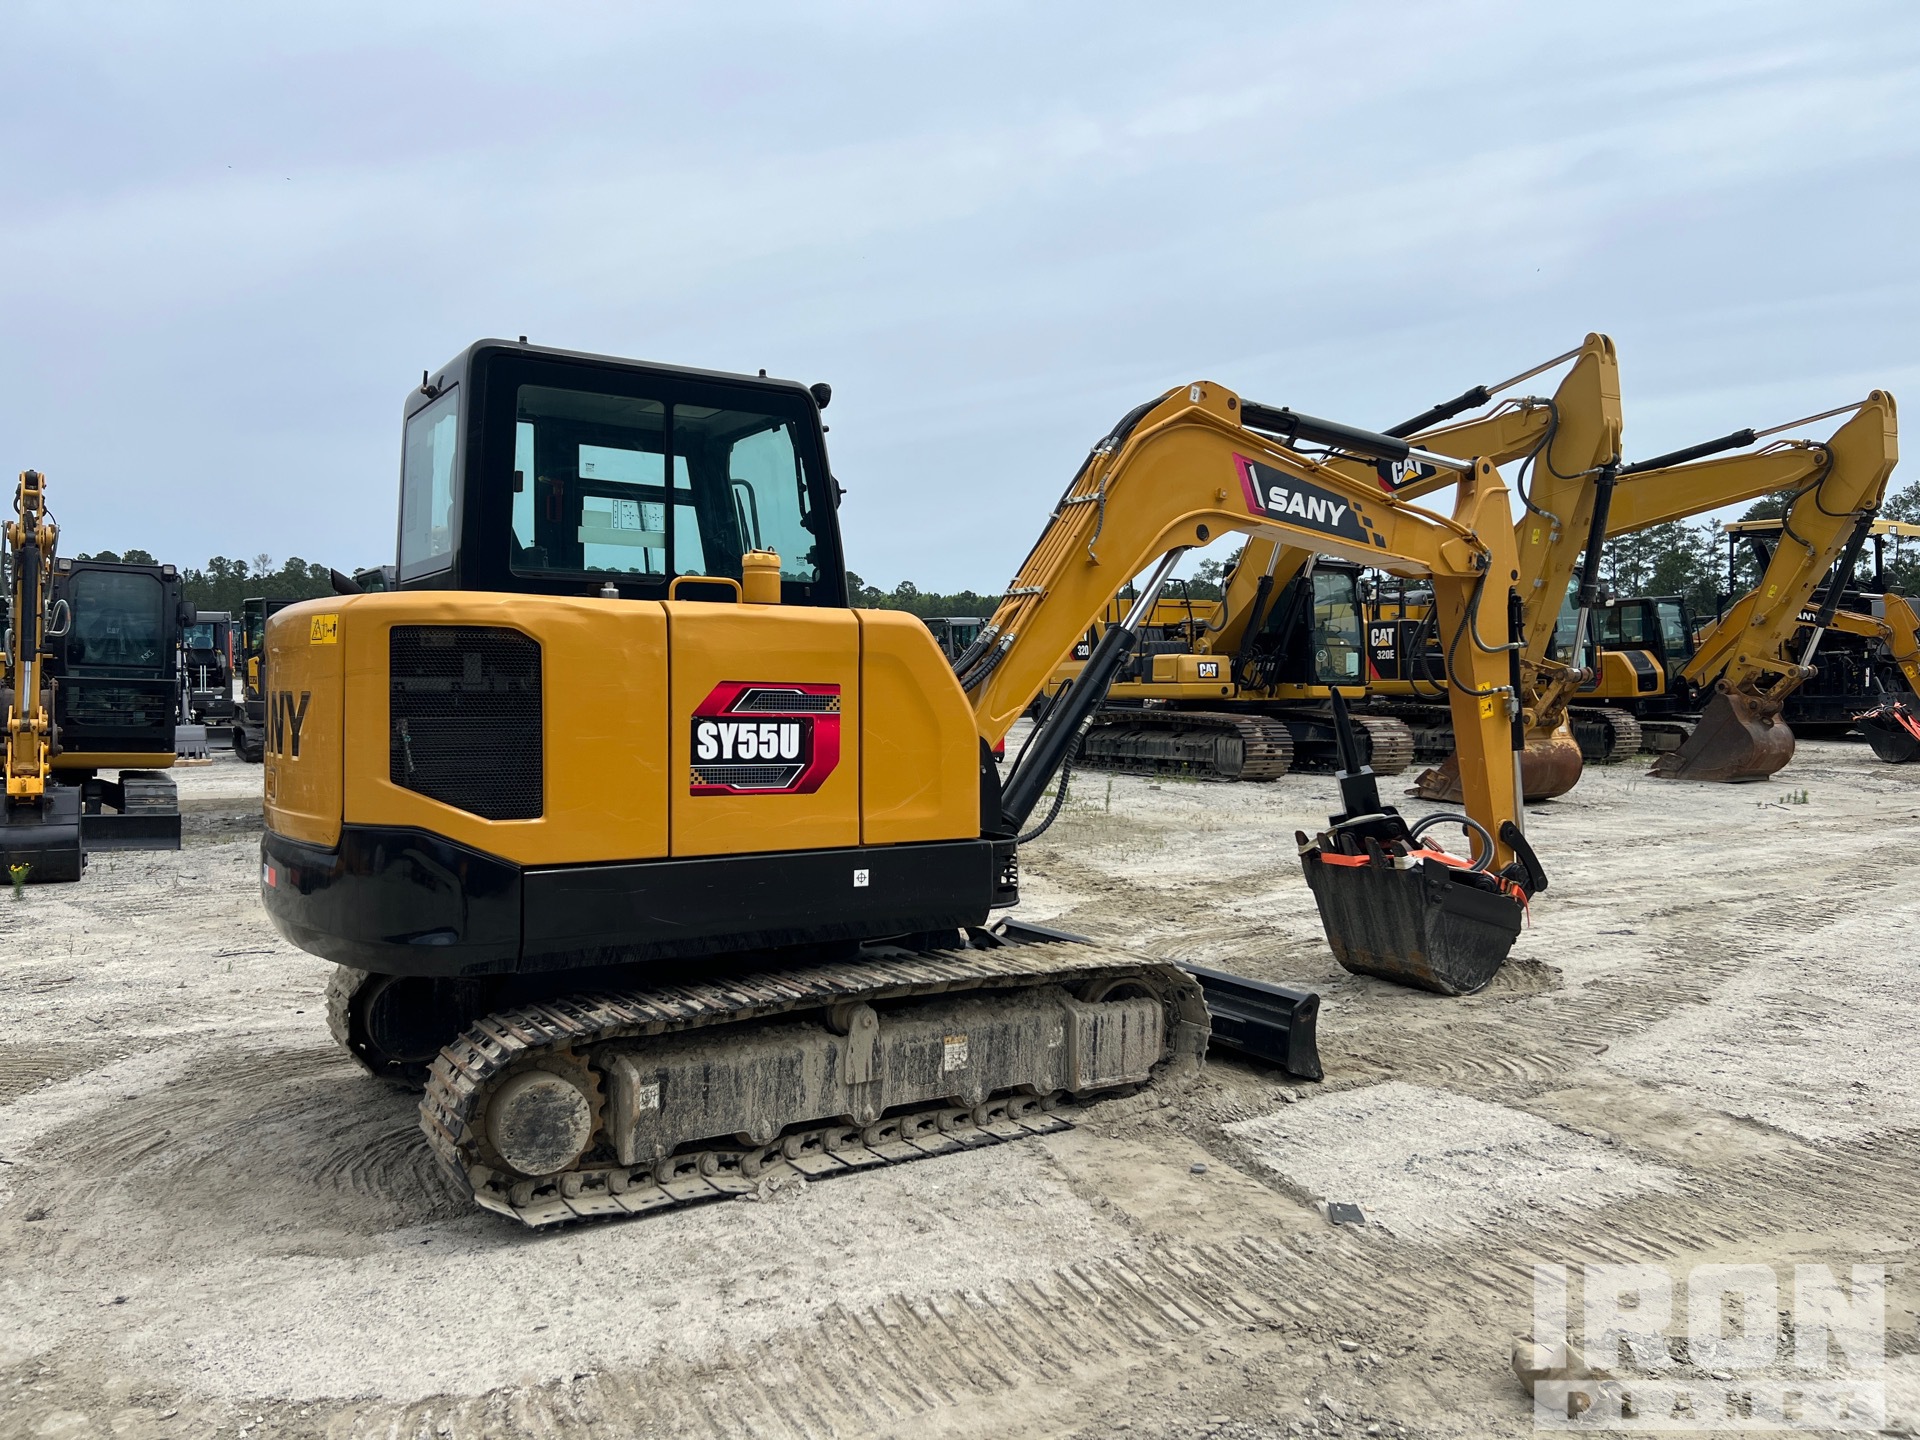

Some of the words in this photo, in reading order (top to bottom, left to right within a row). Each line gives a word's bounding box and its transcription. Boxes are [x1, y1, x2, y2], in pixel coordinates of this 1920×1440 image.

[1268, 486, 1347, 527] SANY
[1371, 628, 1395, 647] CAT
[1376, 650, 1395, 660] 320E
[1199, 663, 1217, 677] CAT
[264, 691, 312, 761] NY
[697, 722, 800, 760] SY55U
